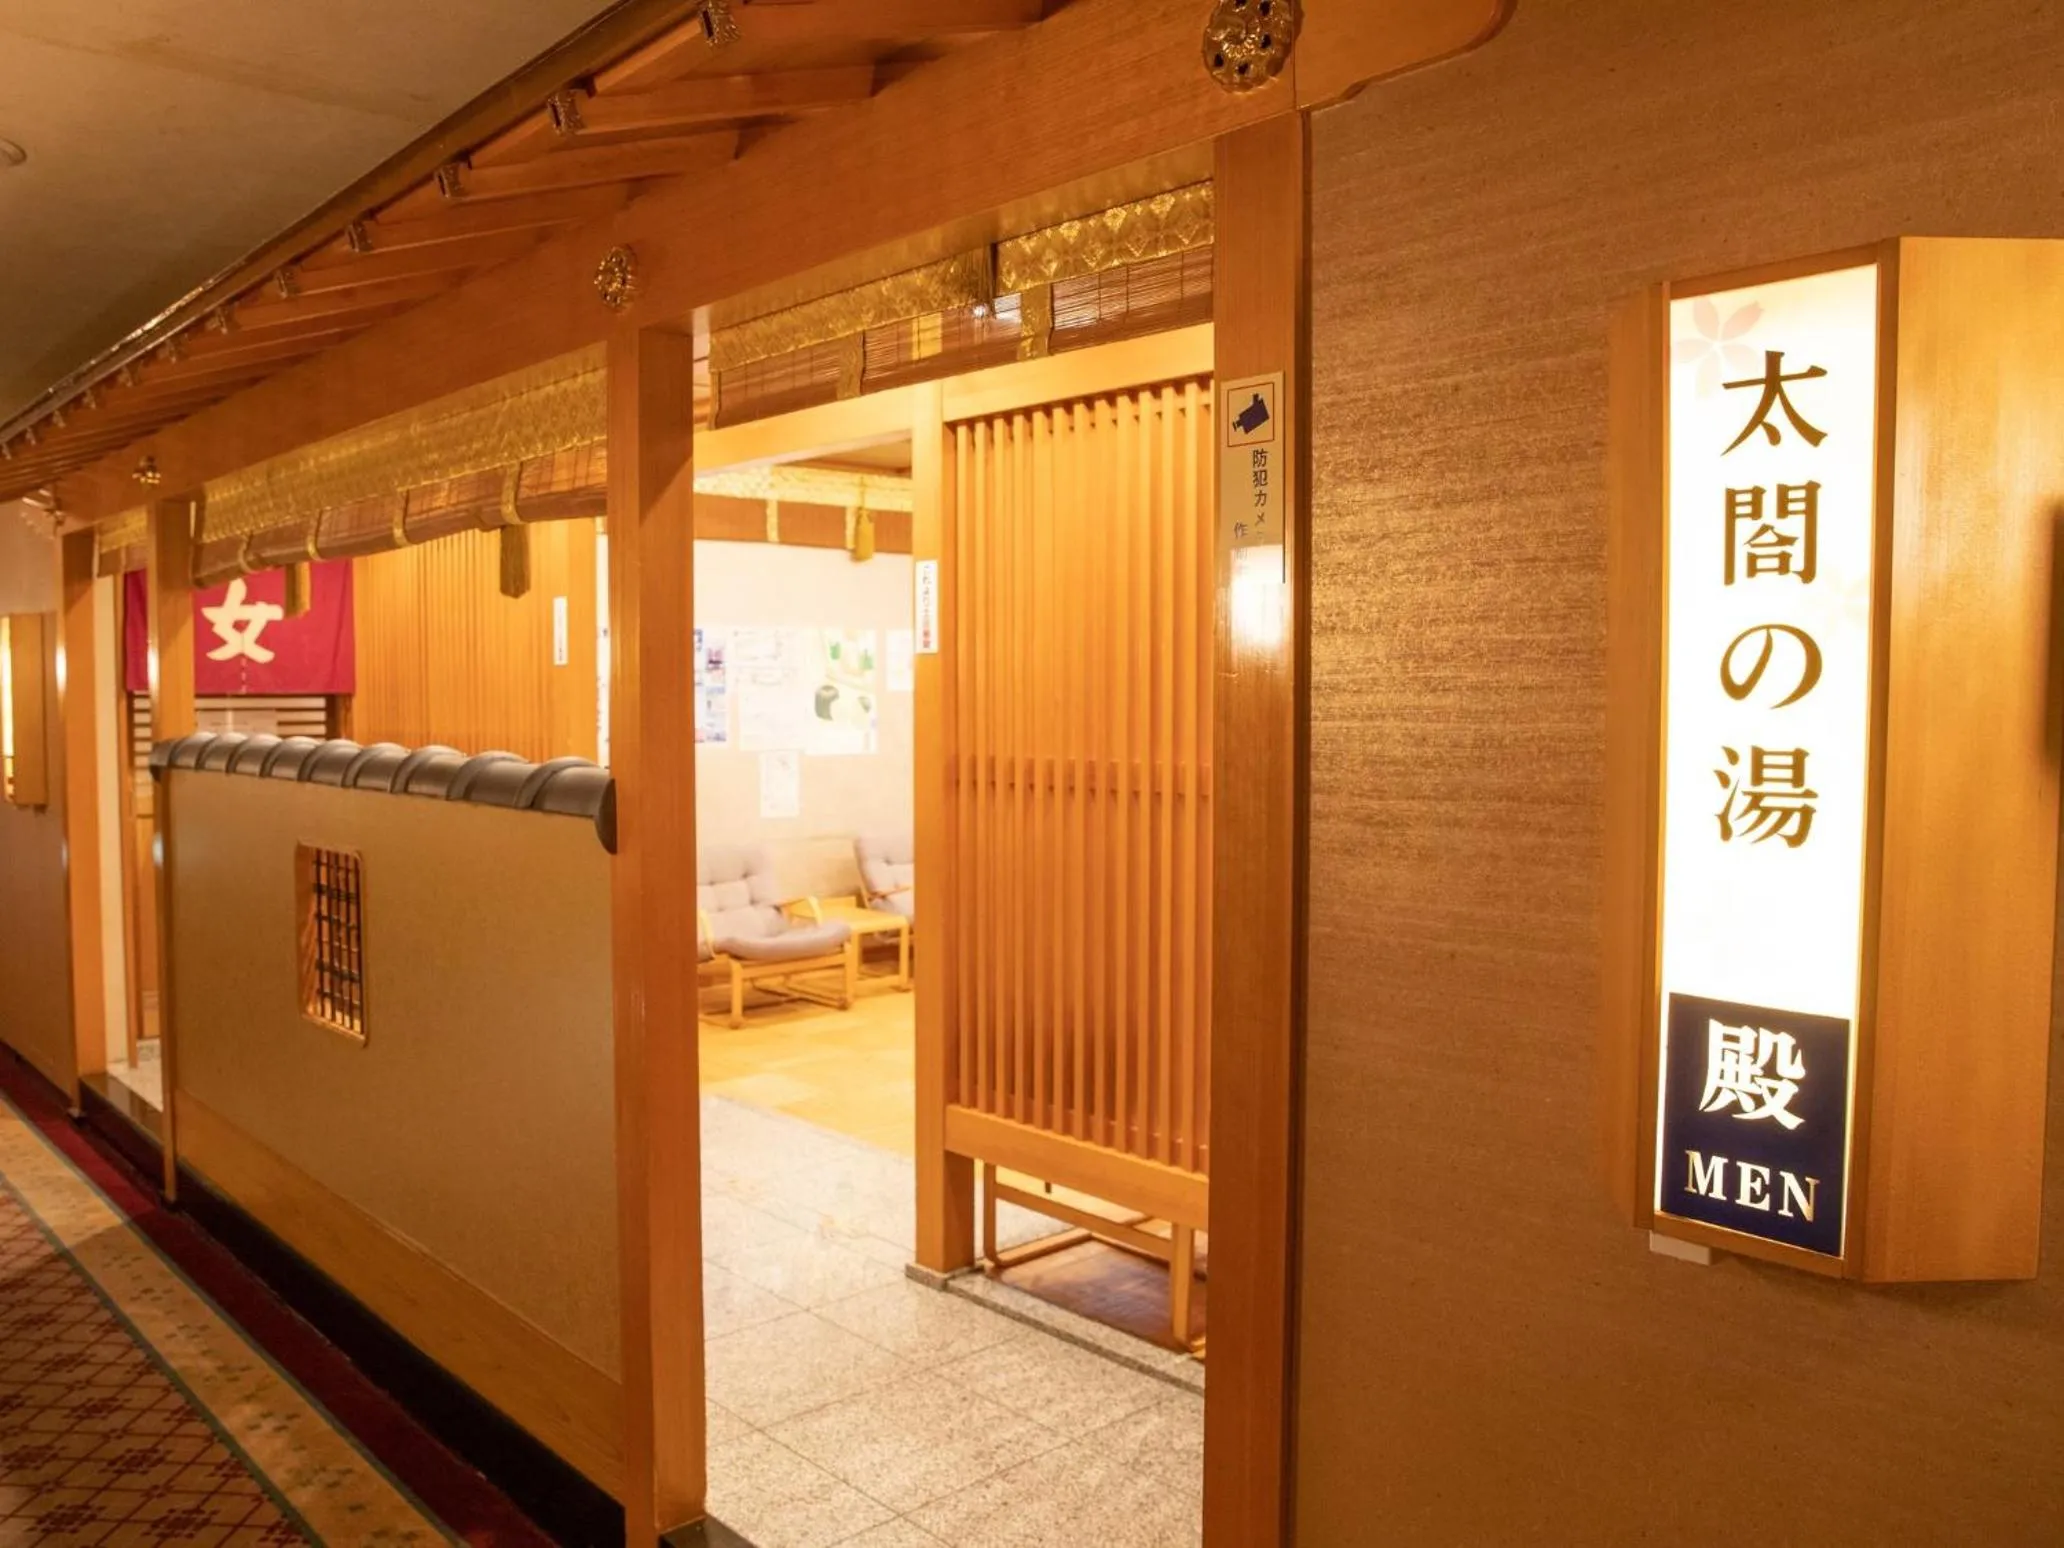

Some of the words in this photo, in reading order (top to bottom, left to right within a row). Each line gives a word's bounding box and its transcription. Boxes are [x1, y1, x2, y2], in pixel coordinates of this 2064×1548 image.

[201, 578, 284, 664] 女
[1713, 350, 1829, 848] 太閤の湯
[1699, 1018, 1806, 1130] 殿
[1684, 1150, 1820, 1222] MEN
